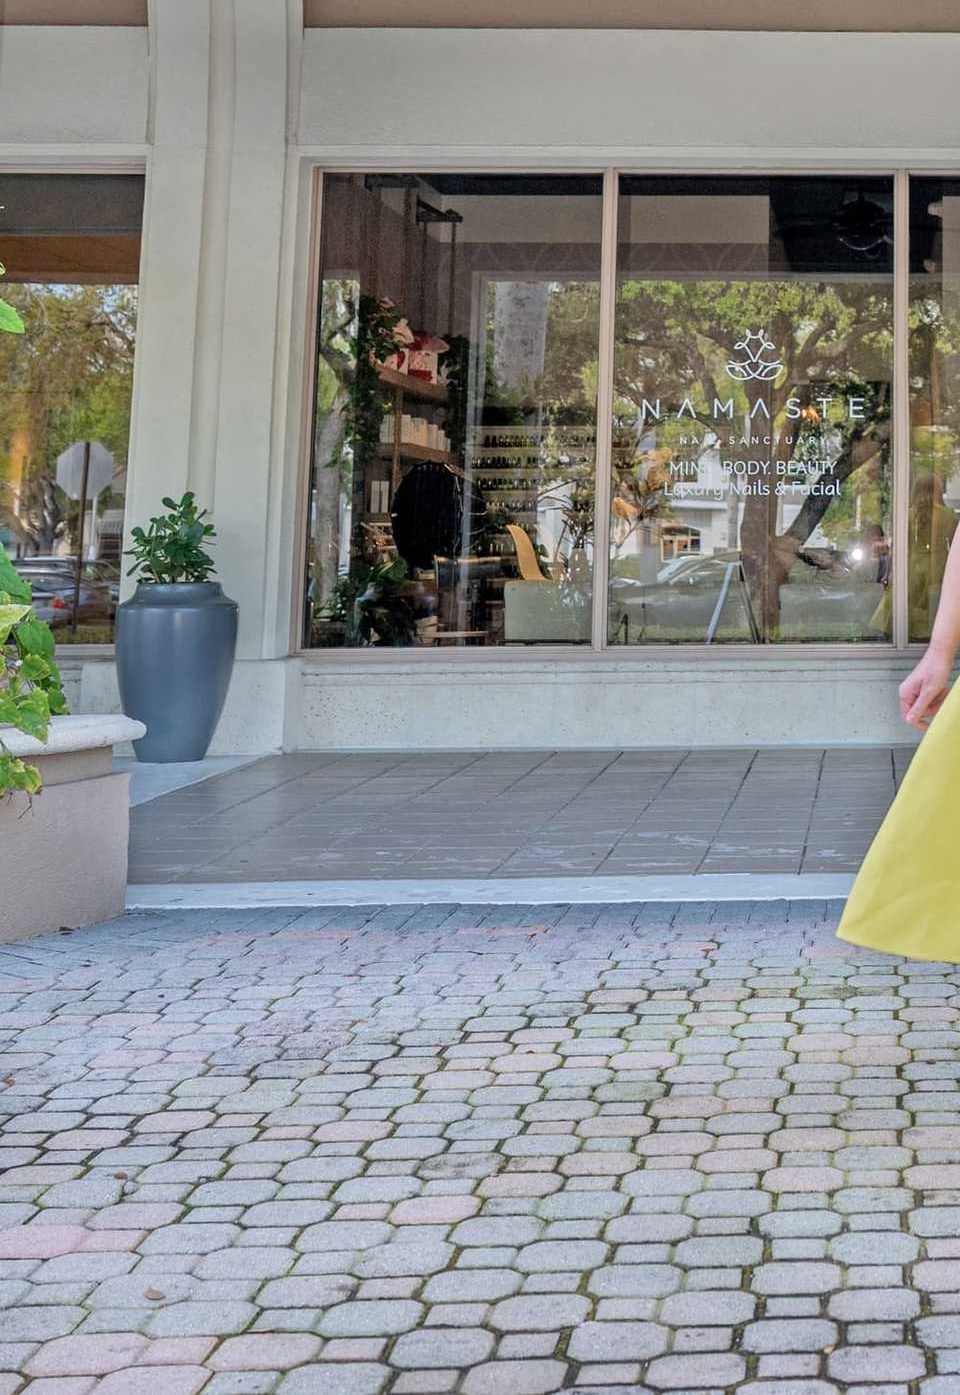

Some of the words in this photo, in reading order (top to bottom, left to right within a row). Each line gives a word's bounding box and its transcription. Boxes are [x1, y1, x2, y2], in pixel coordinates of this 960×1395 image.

[640, 397, 865, 419] NAMASTE
[729, 436, 826, 445] SANCTUARY
[723, 461, 771, 476] BODY.
[776, 461, 837, 476] BEAUTY
[664, 481, 723, 500] Luxury
[730, 480, 770, 495] Nails
[775, 480, 786, 495] &
[791, 479, 841, 495] Facial
